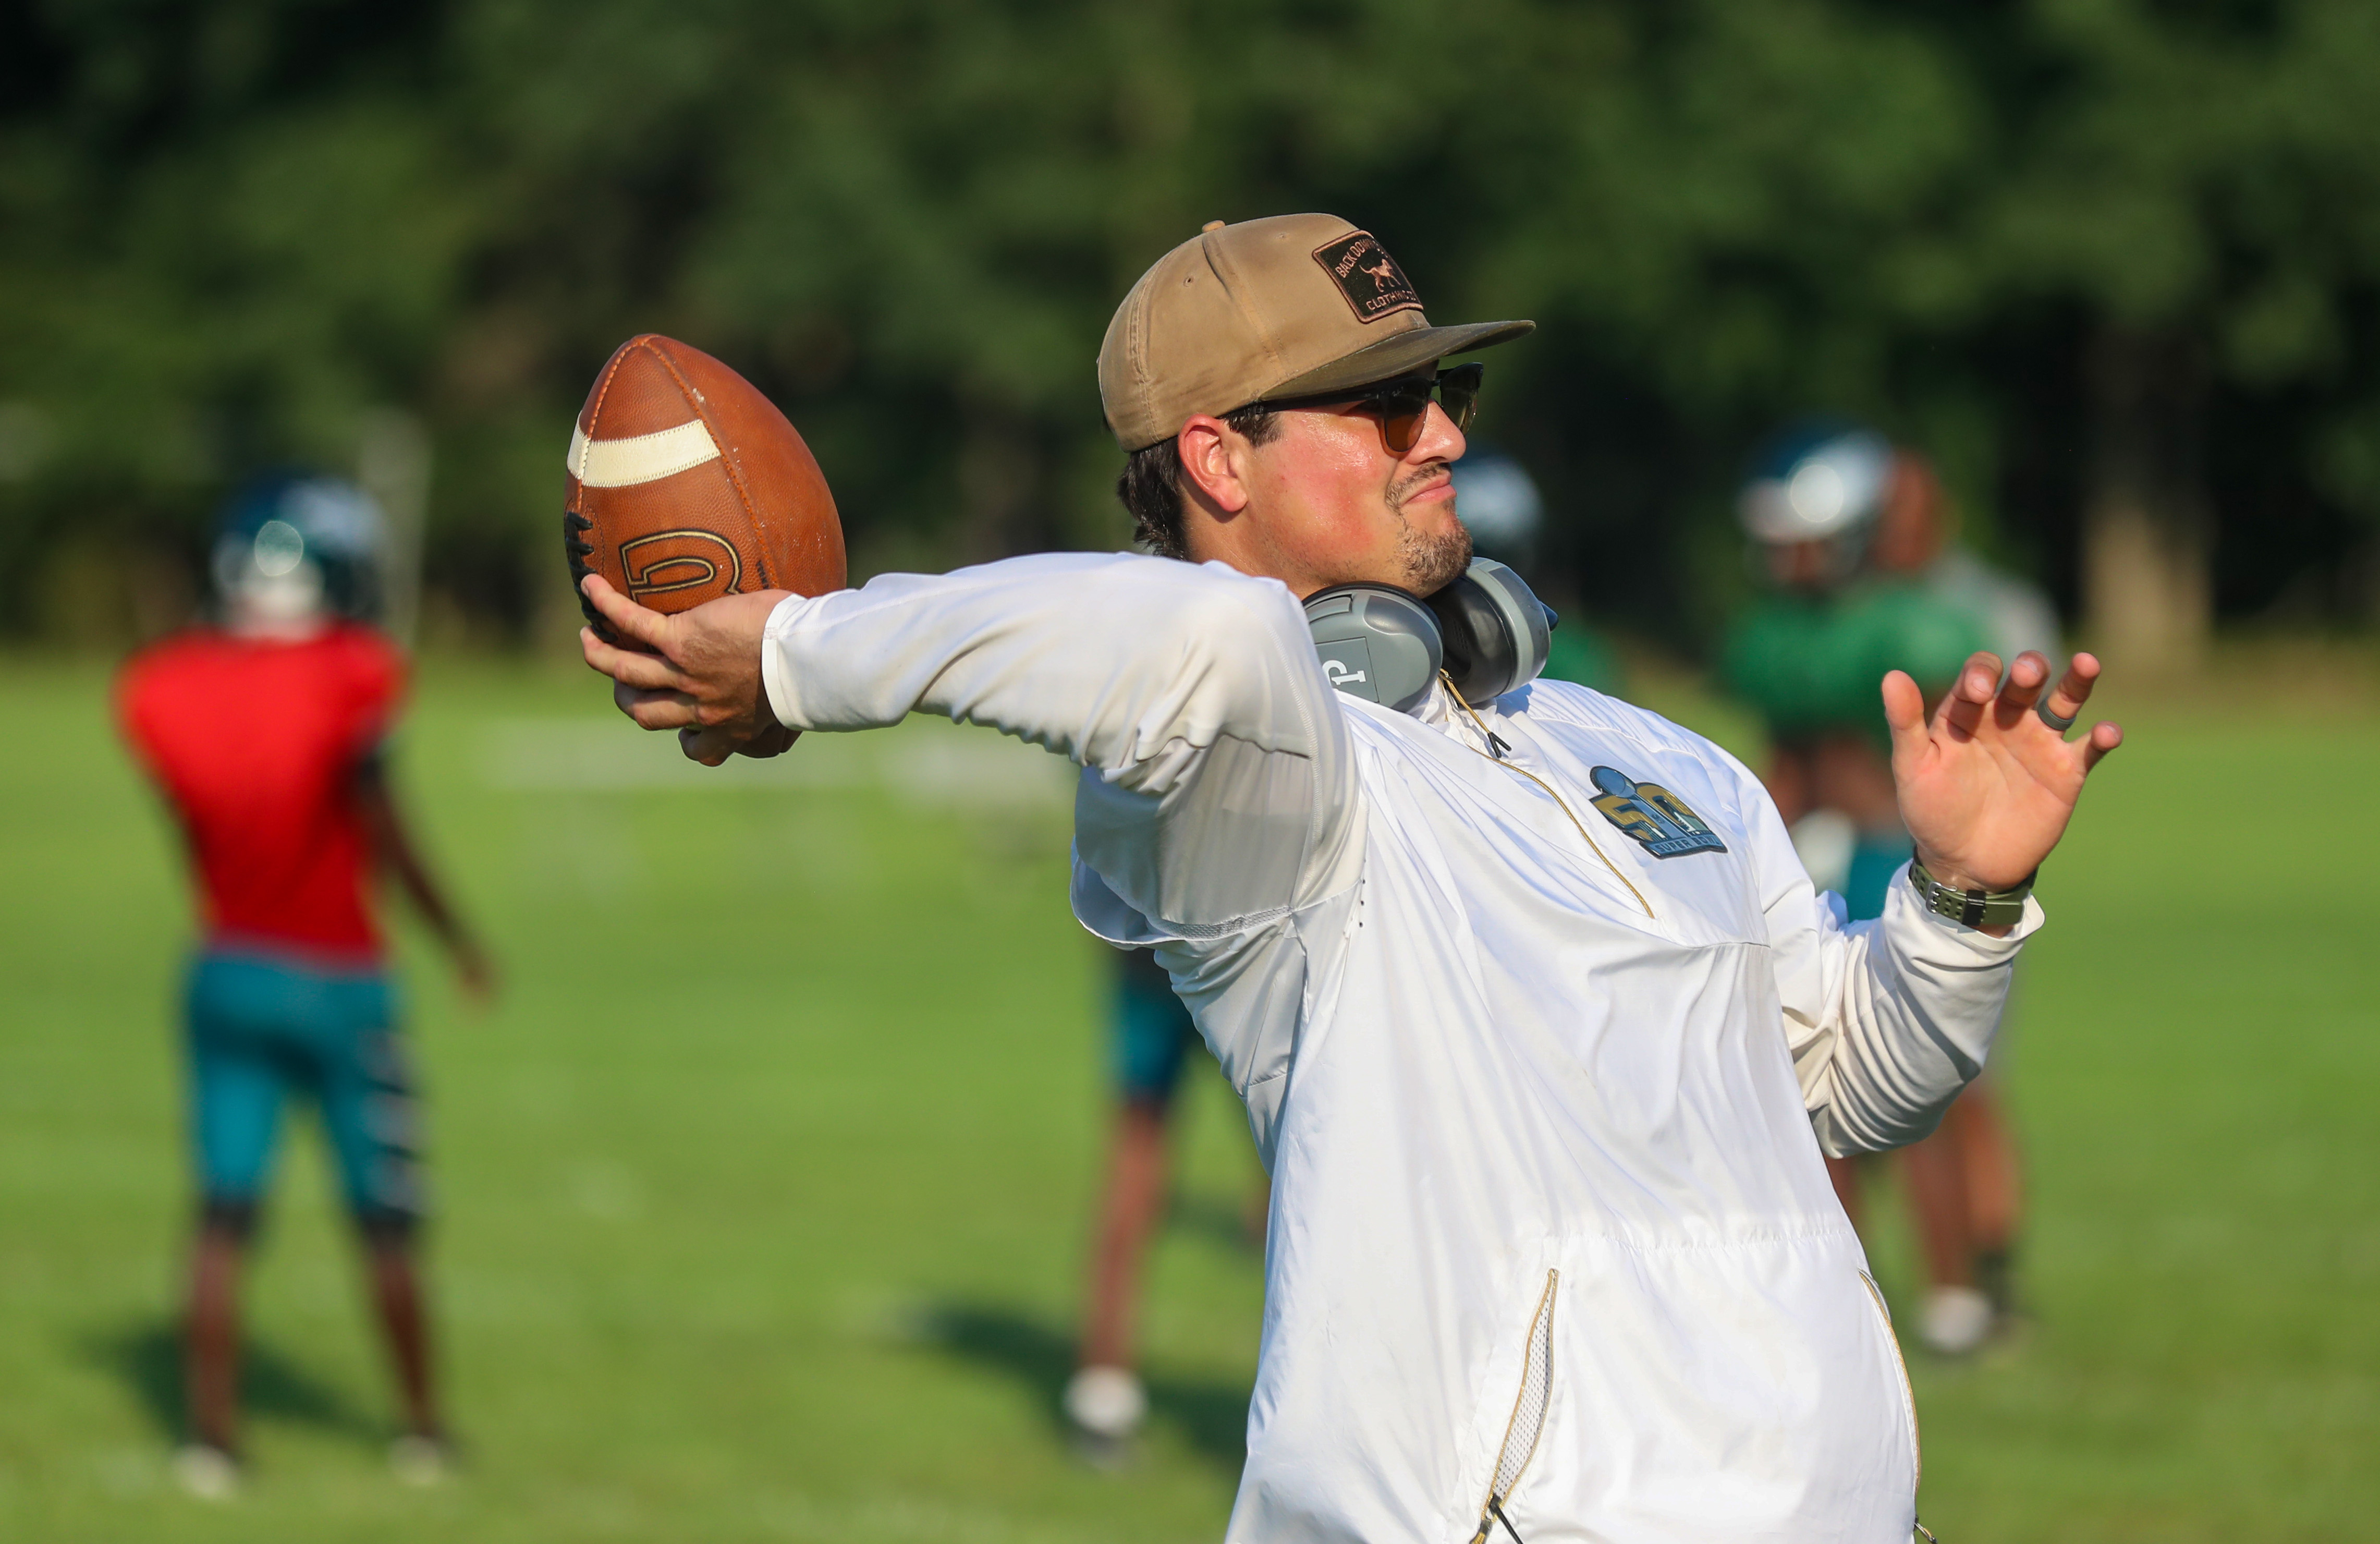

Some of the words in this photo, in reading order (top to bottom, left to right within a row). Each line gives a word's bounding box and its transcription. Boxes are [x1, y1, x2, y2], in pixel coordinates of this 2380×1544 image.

[1335, 251, 1358, 278] BACK
[1655, 836, 1694, 853] SUPER
[1692, 834, 1720, 847] BOWL
